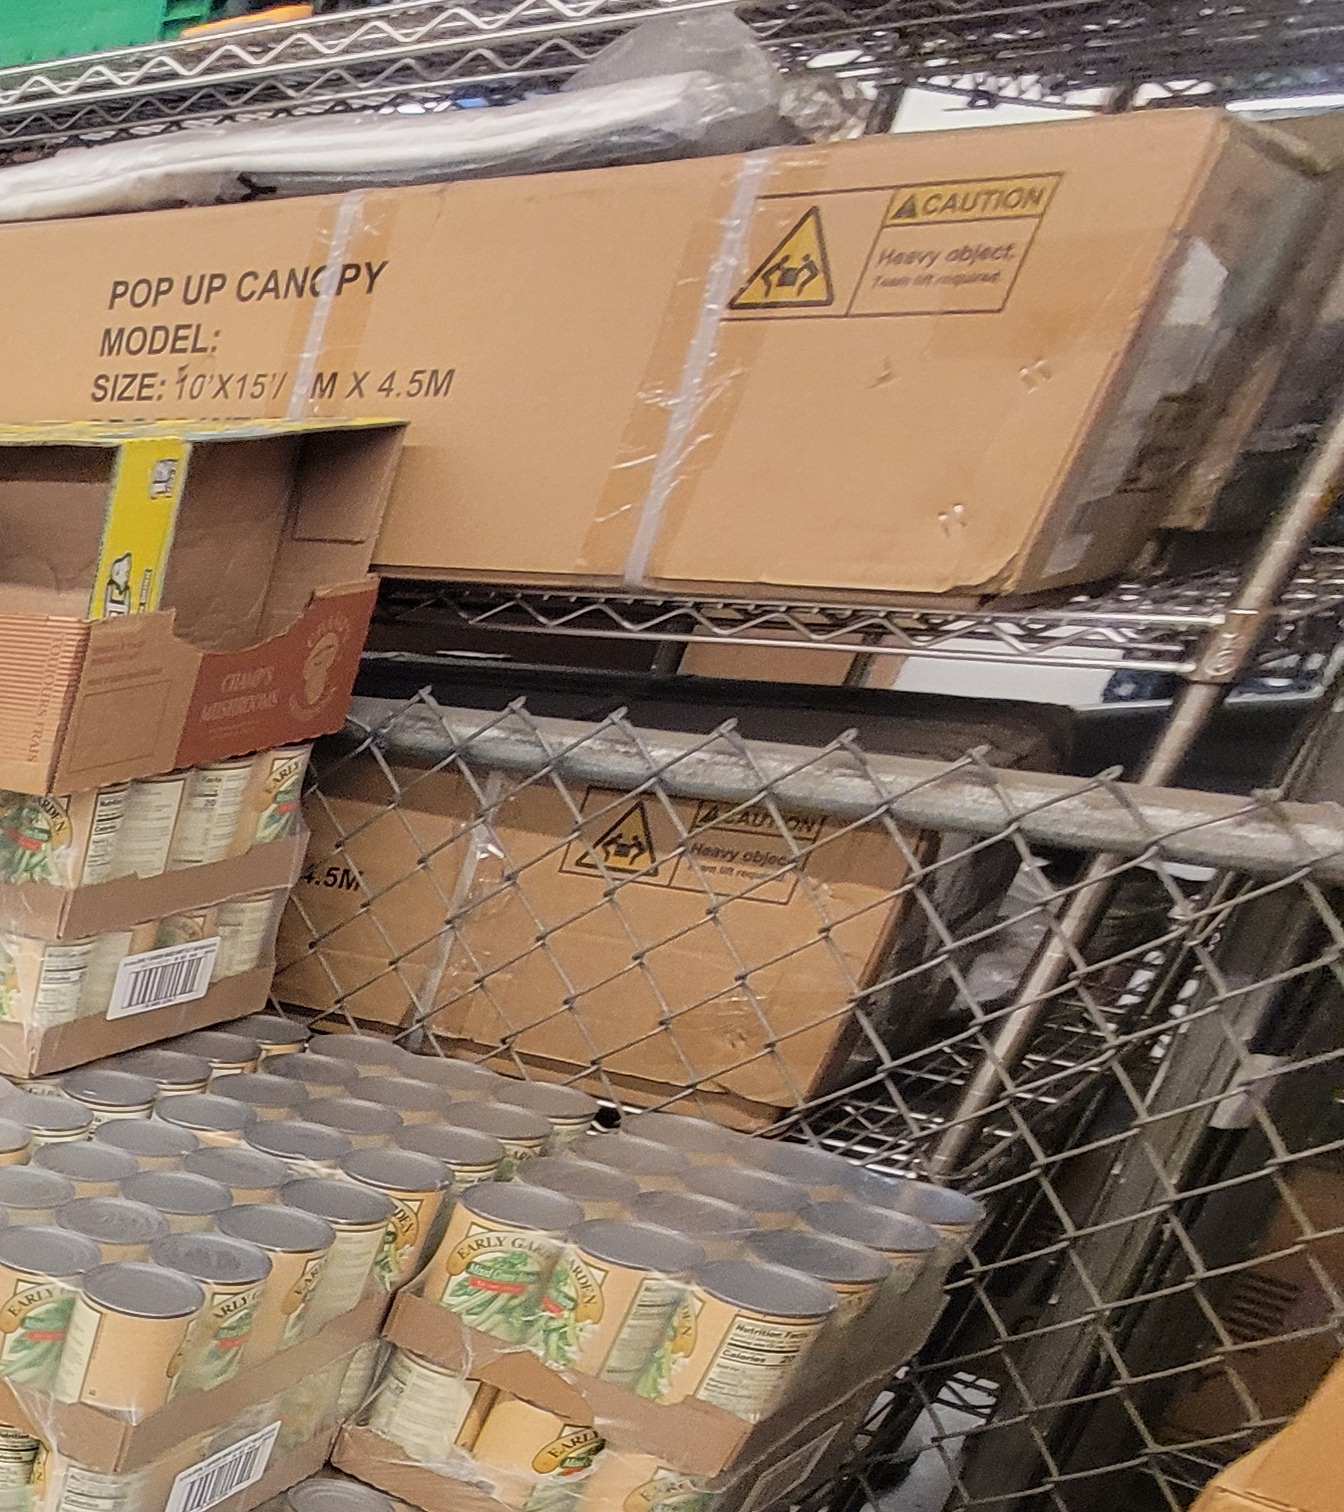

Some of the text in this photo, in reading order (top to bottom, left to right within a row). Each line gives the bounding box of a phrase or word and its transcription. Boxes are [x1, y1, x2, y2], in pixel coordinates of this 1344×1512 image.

[922, 186, 1046, 216] CAUTION
[877, 249, 941, 270] Heavy
[108, 277, 174, 310] POP
[183, 273, 227, 306] UP
[99, 324, 221, 356] MODEL:
[91, 373, 166, 402] SIZE:
[346, 371, 369, 398] X
[377, 369, 455, 398] 4.5M
[457, 1235, 508, 1259] EARLY
[7, 1288, 53, 1316] EARLY
[735, 1323, 782, 1338] Nutrition
[722, 1349, 766, 1363] Calories
